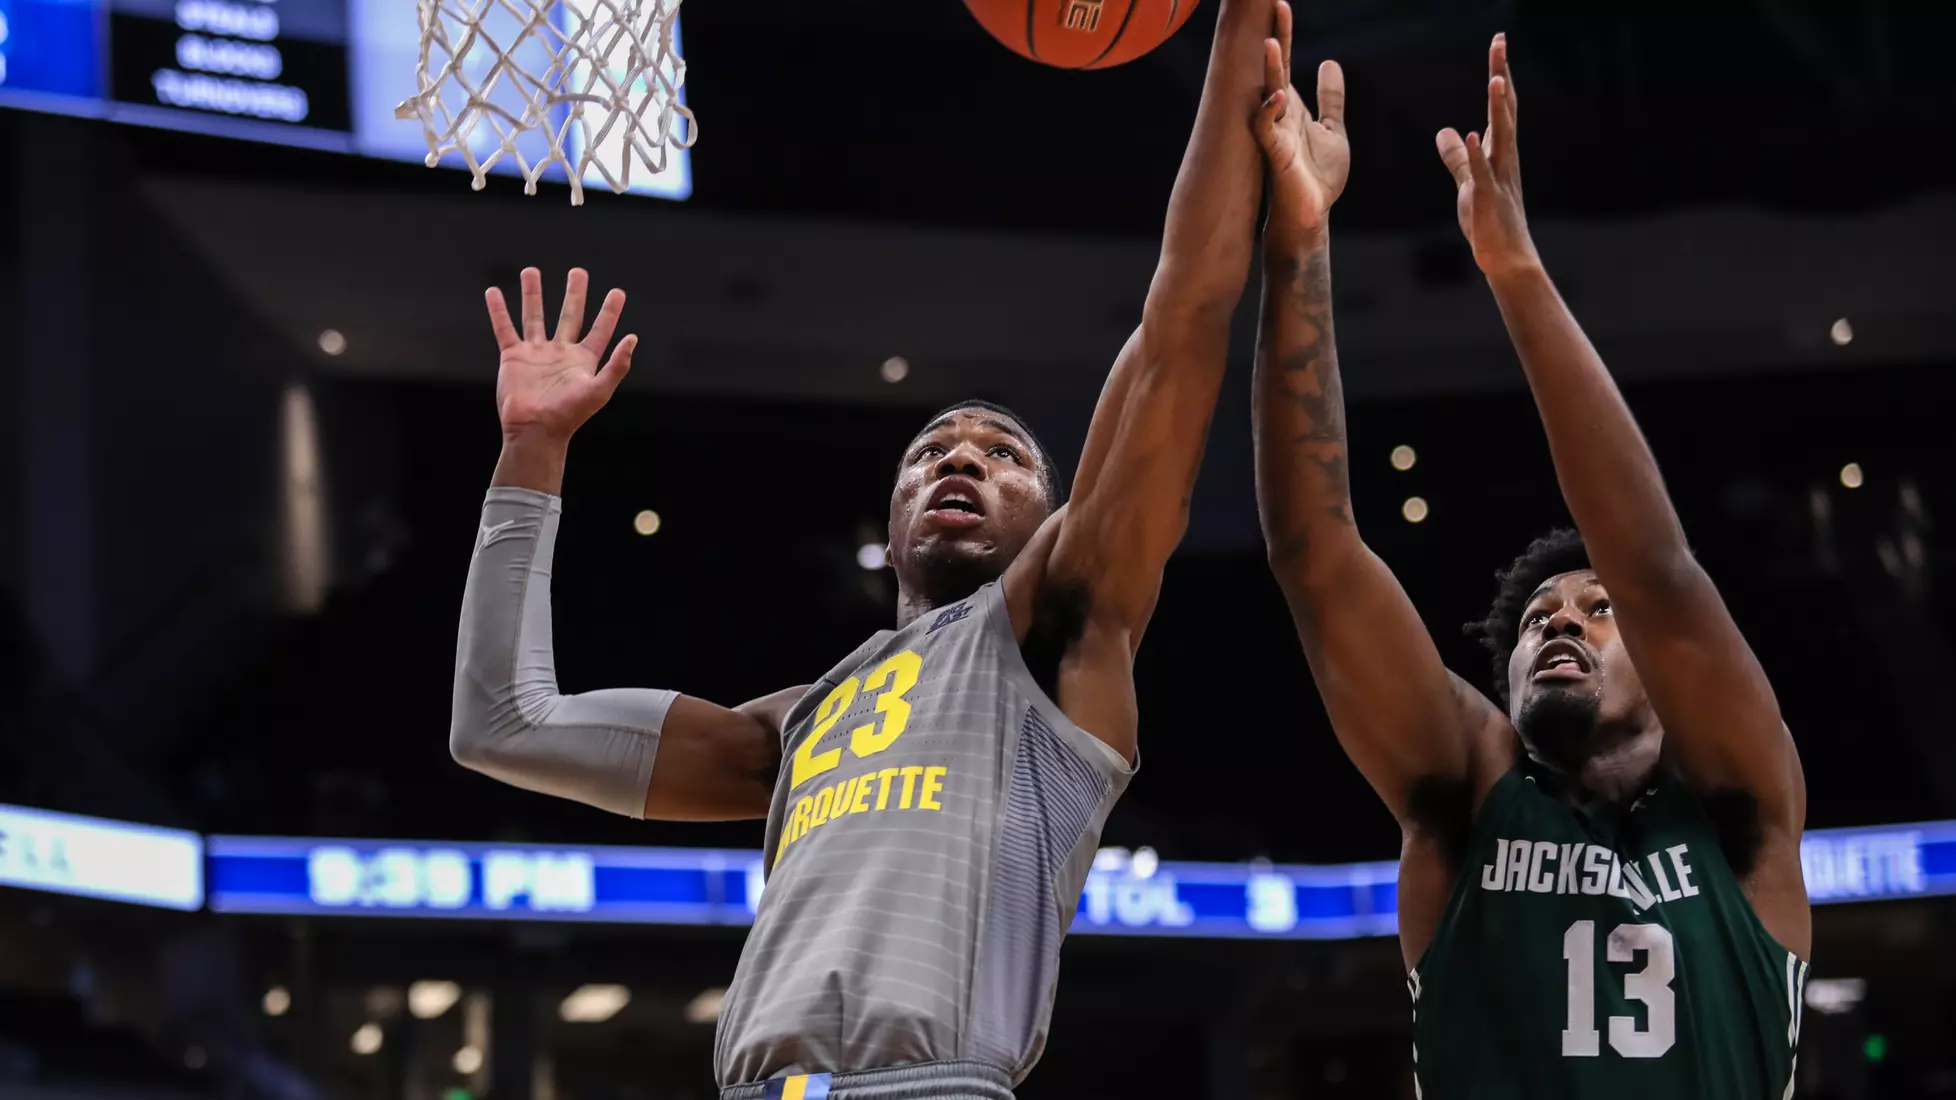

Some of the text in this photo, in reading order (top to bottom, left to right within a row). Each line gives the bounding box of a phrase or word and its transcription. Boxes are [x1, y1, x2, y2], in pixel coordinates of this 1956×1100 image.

[792, 649, 923, 791] 23
[481, 850, 595, 912] PM
[1562, 920, 1676, 1058] 13
